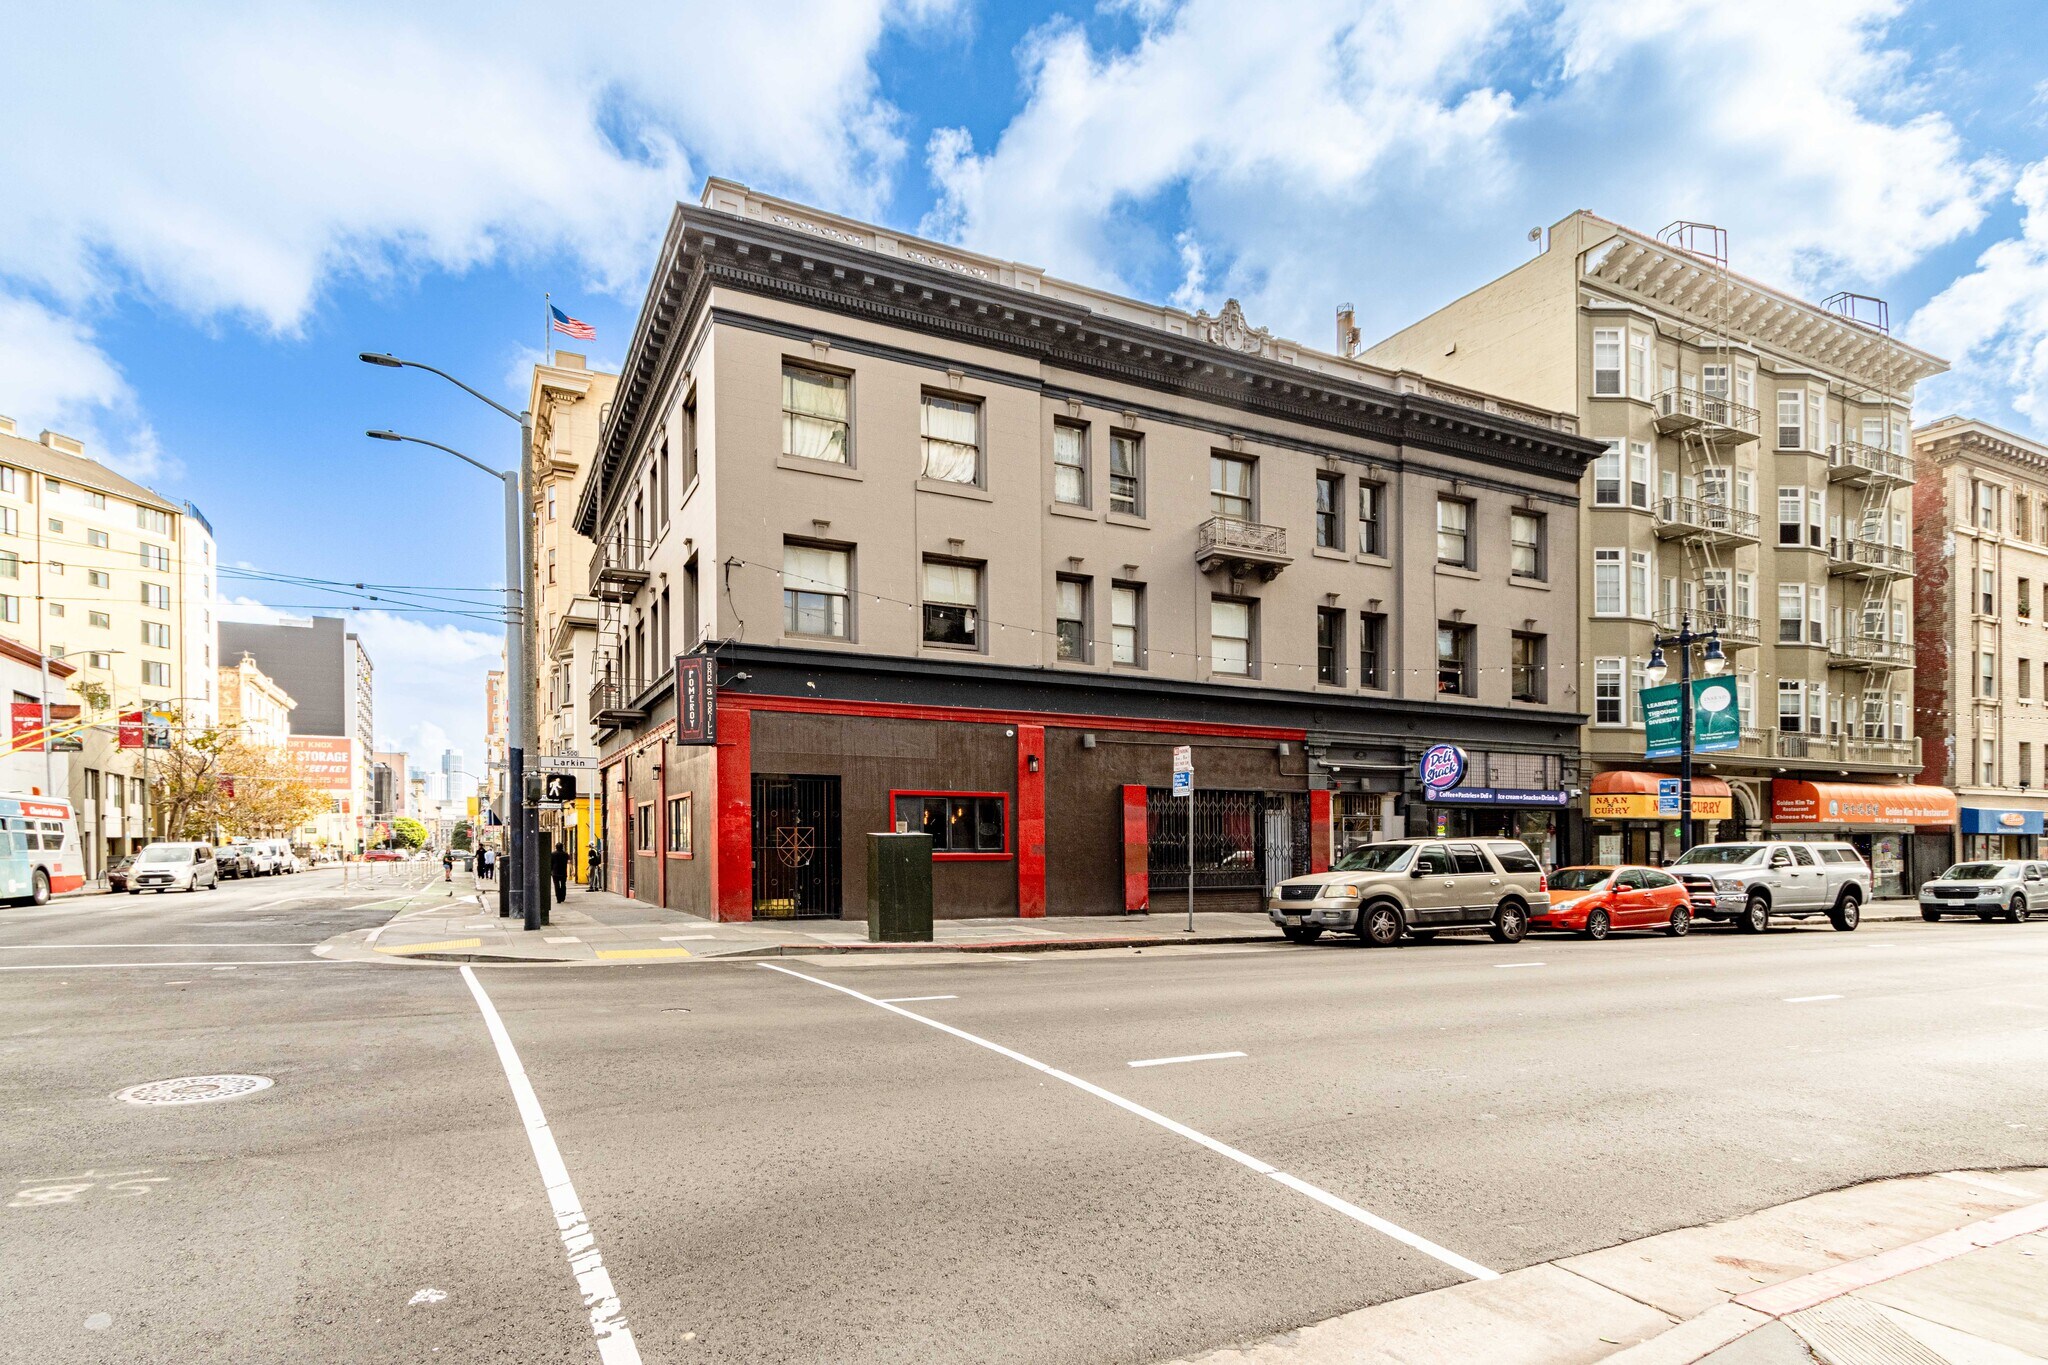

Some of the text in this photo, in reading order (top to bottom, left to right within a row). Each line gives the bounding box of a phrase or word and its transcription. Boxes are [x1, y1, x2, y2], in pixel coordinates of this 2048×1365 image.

[1646, 699, 1678, 709] LEARNING
[1648, 707, 1678, 716] THROUGH
[1649, 716, 1681, 725] DIVERSITY
[297, 751, 349, 762] STORAGE
[1430, 749, 1454, 768] Deli
[553, 758, 585, 767] Larkin
[329, 765, 347, 773] KEY
[1426, 762, 1459, 783] Shack
[1594, 806, 1630, 815] CURRY
[1691, 800, 1721, 814] CURRY
[1885, 807, 1949, 817] Golden Kim Tar Restaurant
